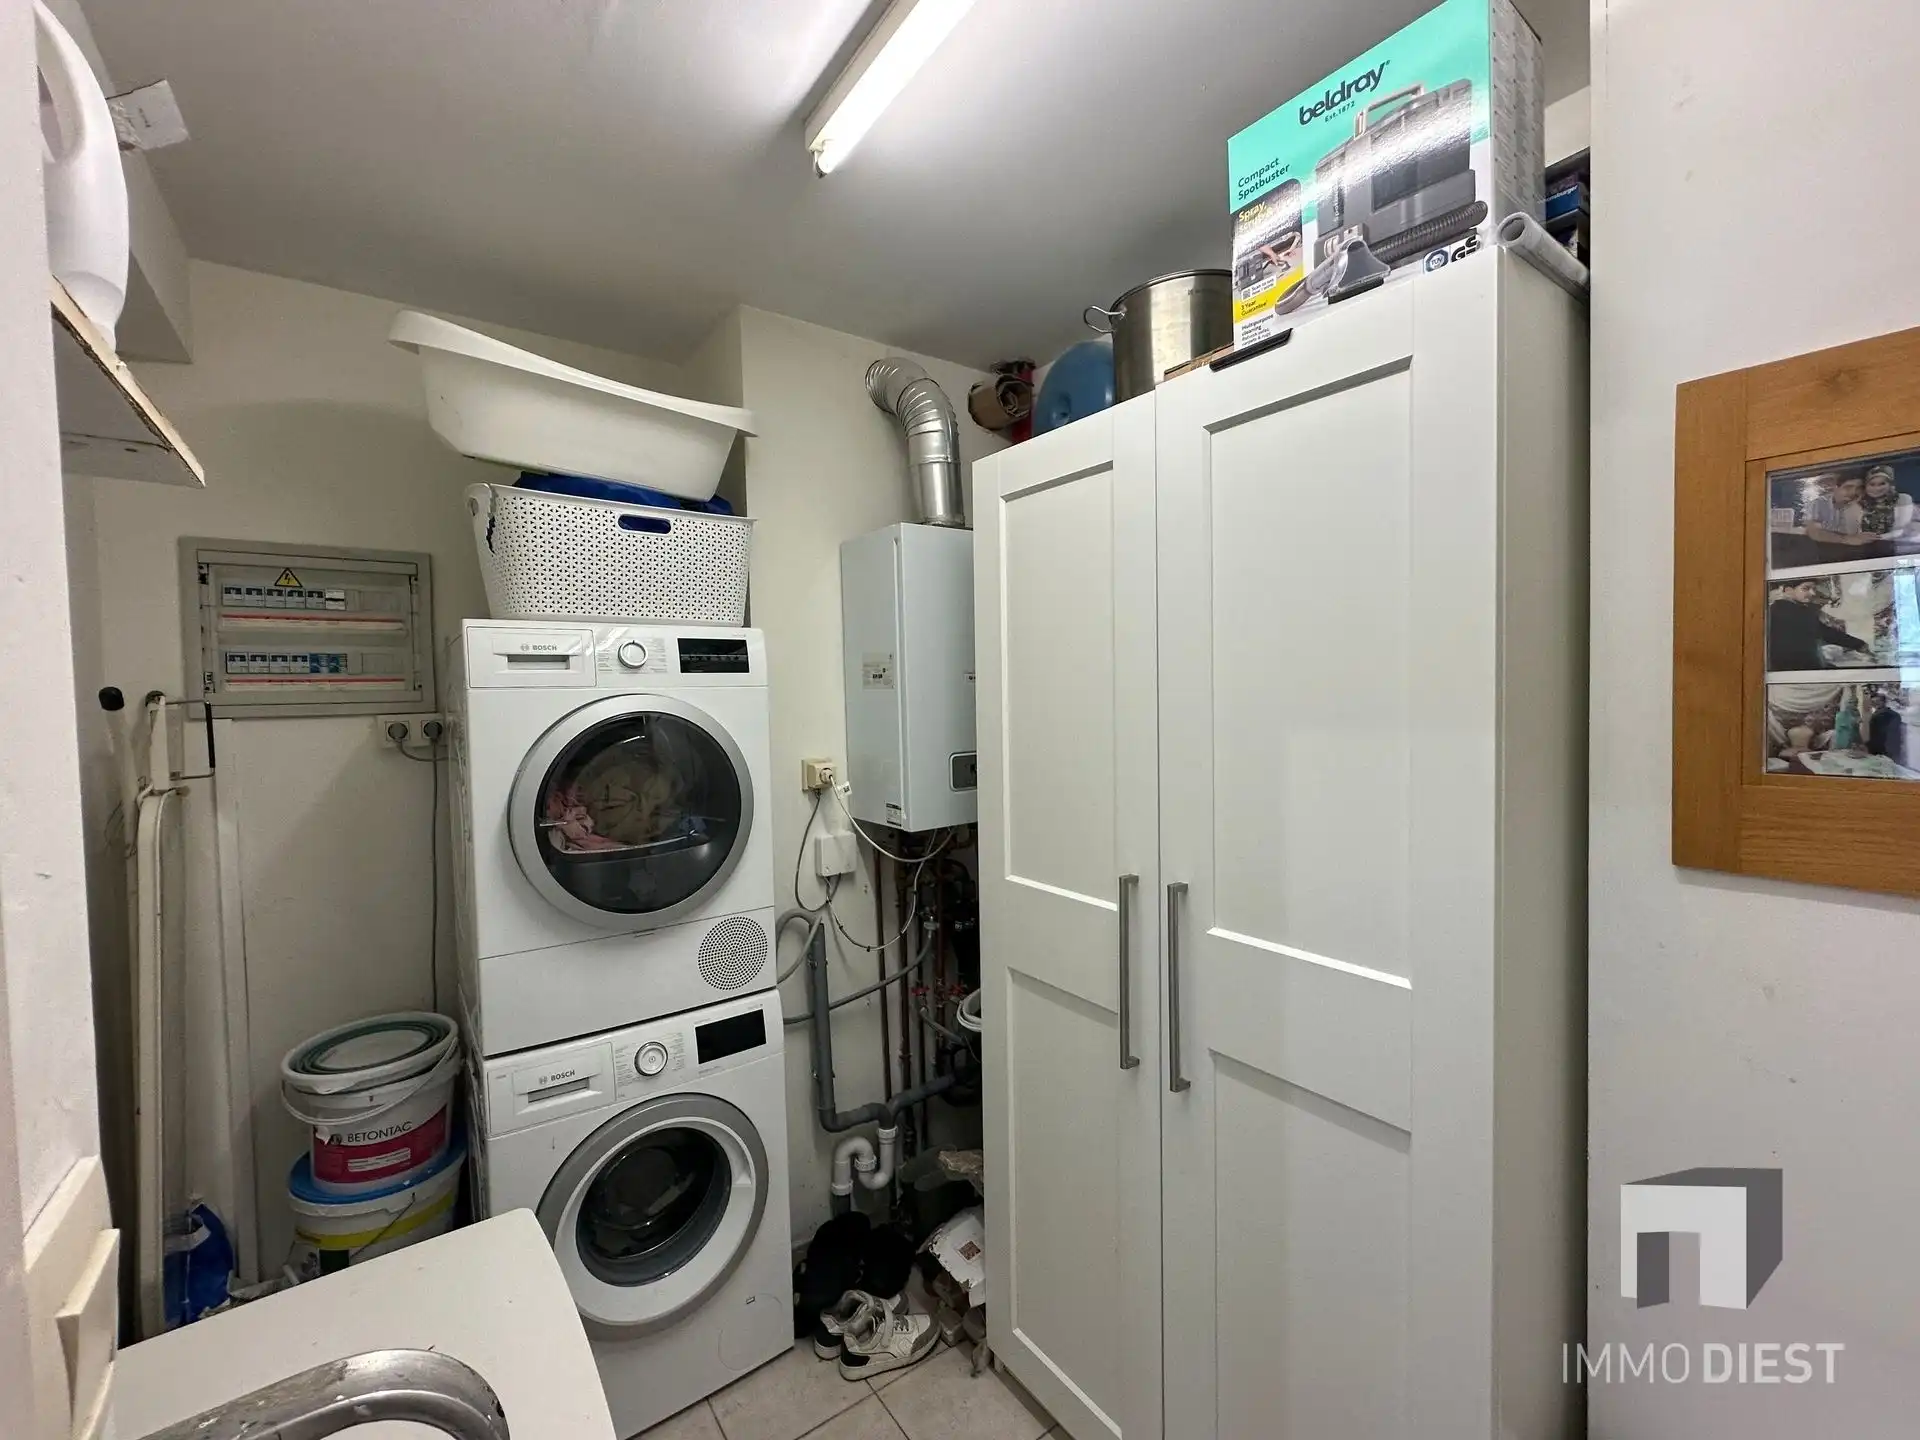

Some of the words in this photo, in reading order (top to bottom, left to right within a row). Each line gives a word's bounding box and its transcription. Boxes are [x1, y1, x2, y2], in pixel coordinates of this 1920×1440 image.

[1299, 62, 1386, 126] beldray
[1237, 158, 1280, 188] Compact
[1237, 164, 1291, 201] Spotbuster
[1451, 234, 1481, 263] GS
[532, 644, 558, 652] BOSCH
[550, 1069, 576, 1082] BOSCH
